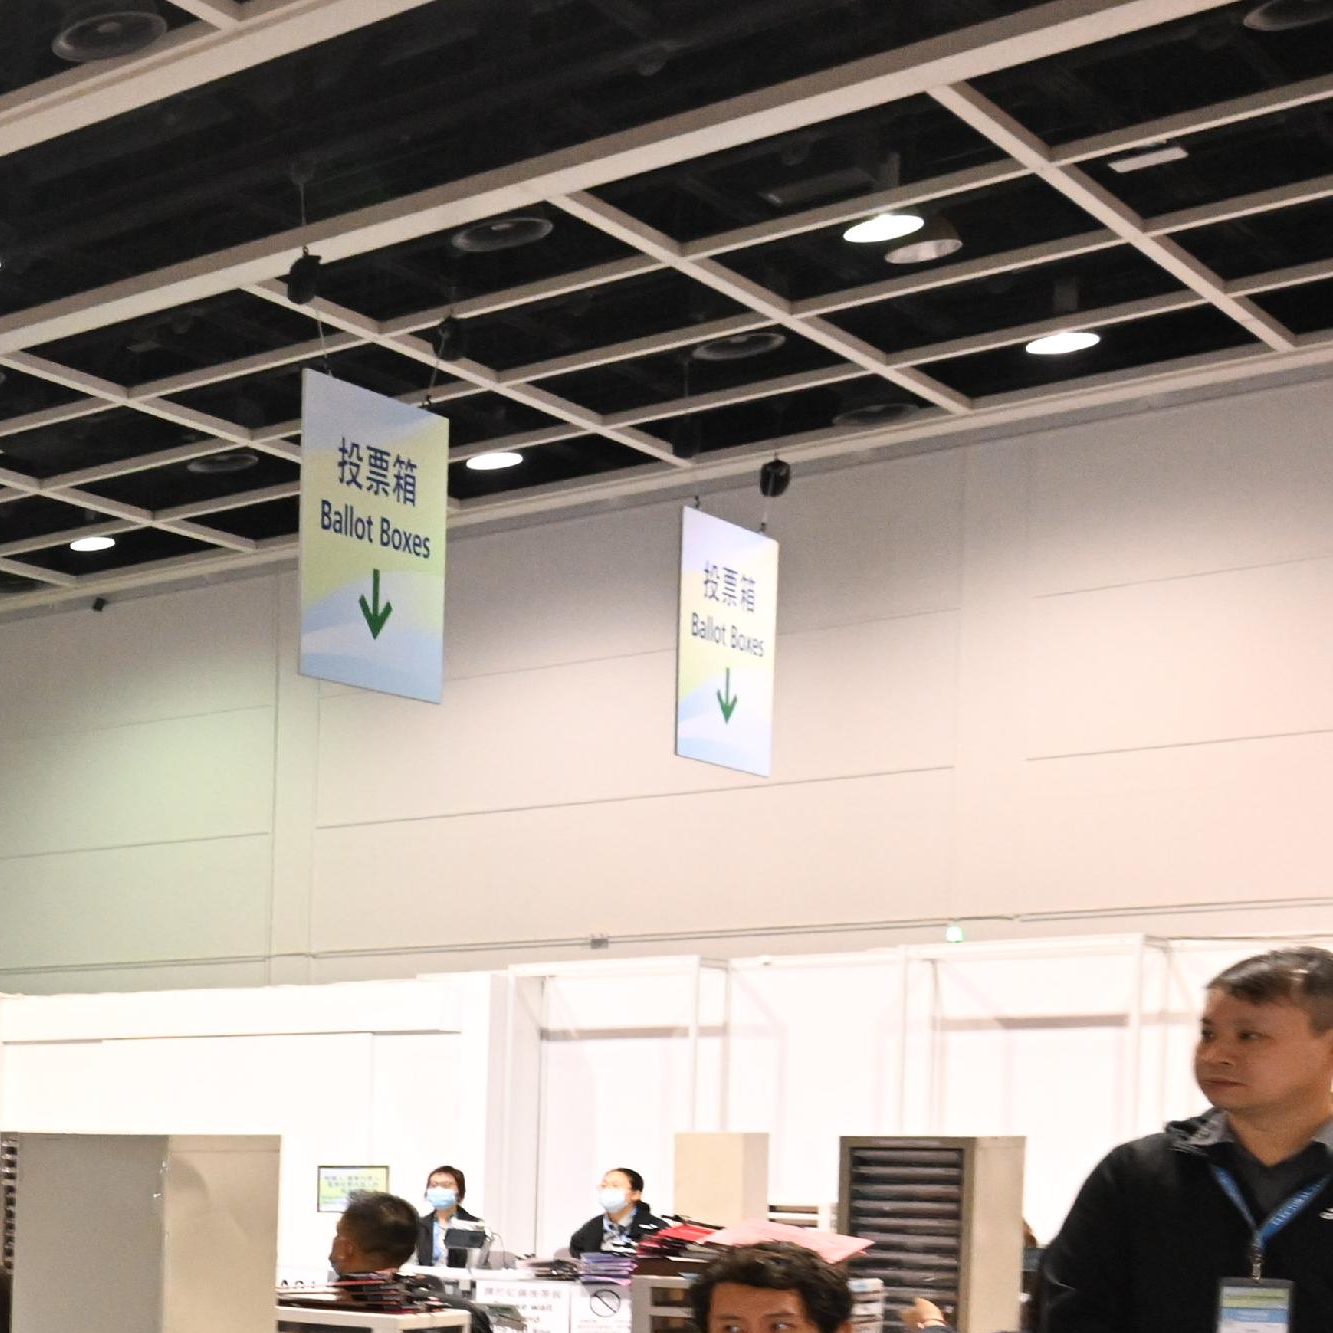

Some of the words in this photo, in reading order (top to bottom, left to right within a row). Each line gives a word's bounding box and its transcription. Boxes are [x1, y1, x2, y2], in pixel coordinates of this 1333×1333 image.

[337, 437, 417, 507] 投票箱
[320, 499, 374, 544] Ballot
[380, 516, 430, 559] Boxes
[703, 561, 755, 613] 投票箱
[692, 611, 726, 646] Ballot
[731, 625, 764, 657] Boxes
